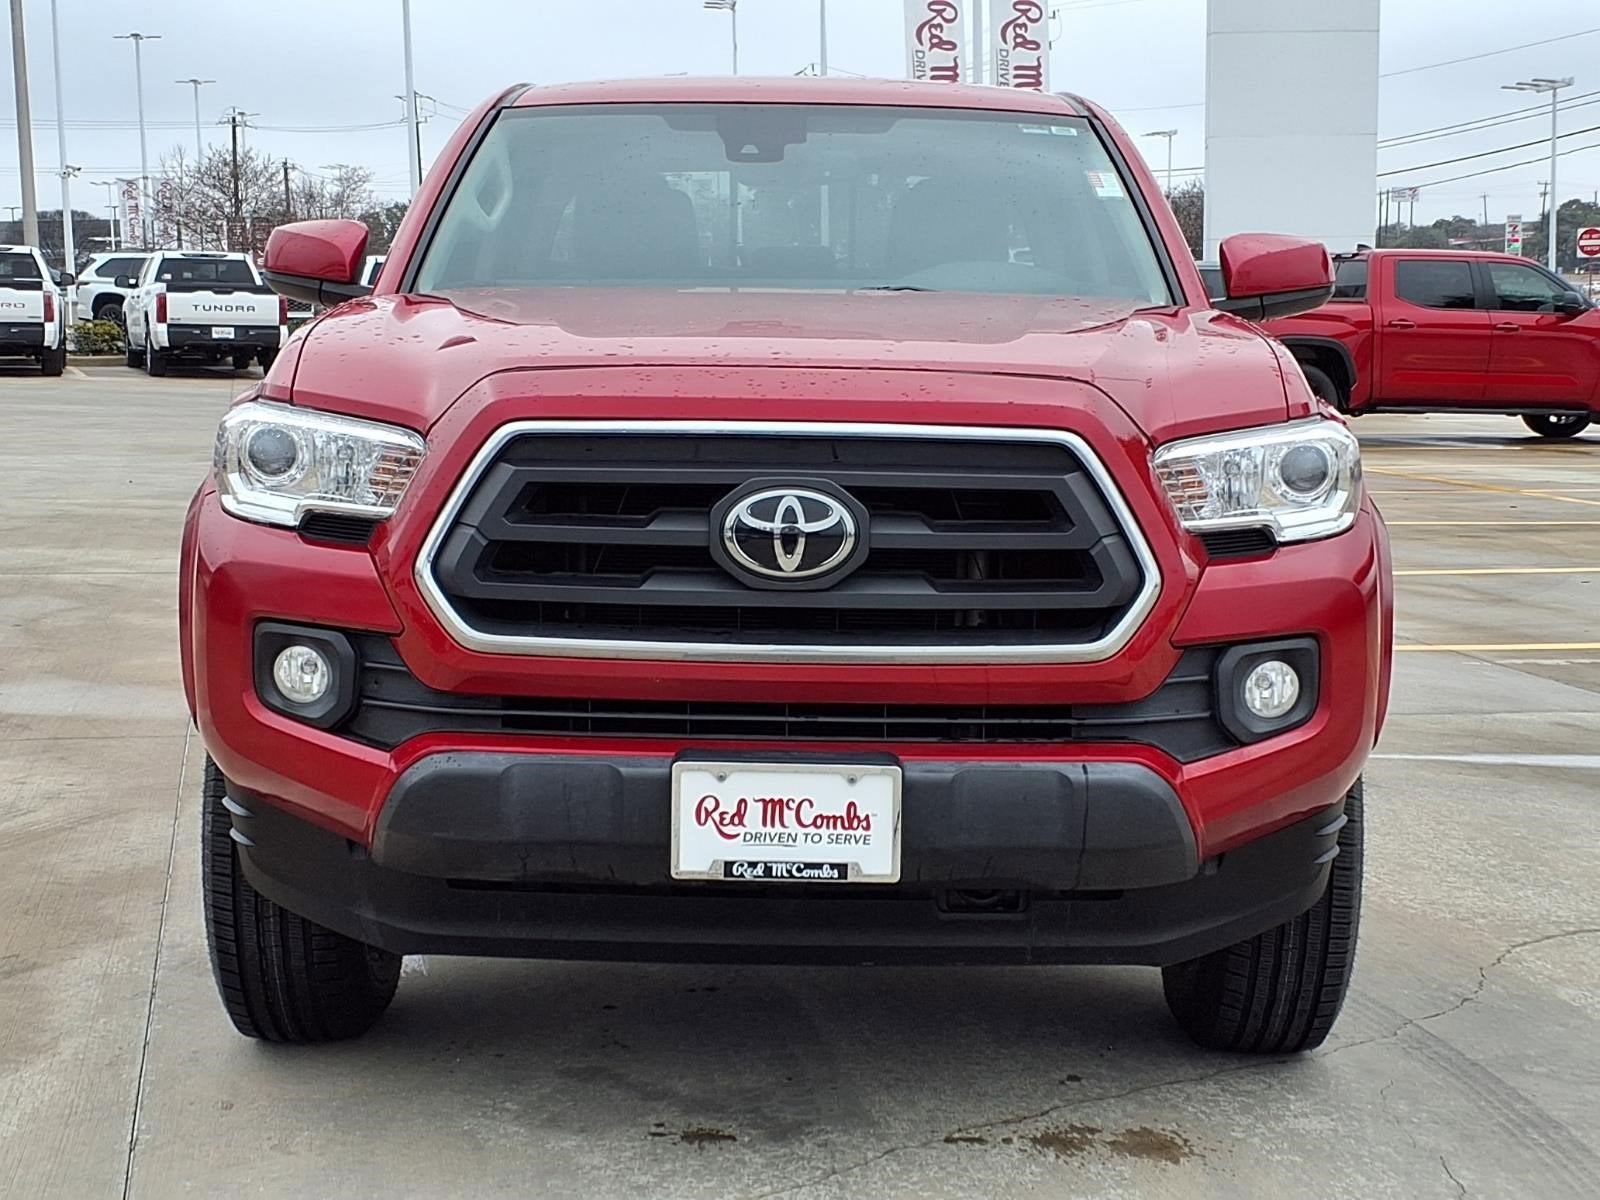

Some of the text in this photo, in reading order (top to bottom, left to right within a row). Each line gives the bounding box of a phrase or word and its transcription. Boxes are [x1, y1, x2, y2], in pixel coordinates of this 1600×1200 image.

[915, 0, 958, 51] Red
[1000, 0, 1043, 51] Red
[192, 304, 256, 312] TUNDRA
[695, 795, 871, 840] Red McCombs
[742, 831, 872, 845] DRIVEN TO SERVE
[732, 861, 838, 878] Red McCombs
